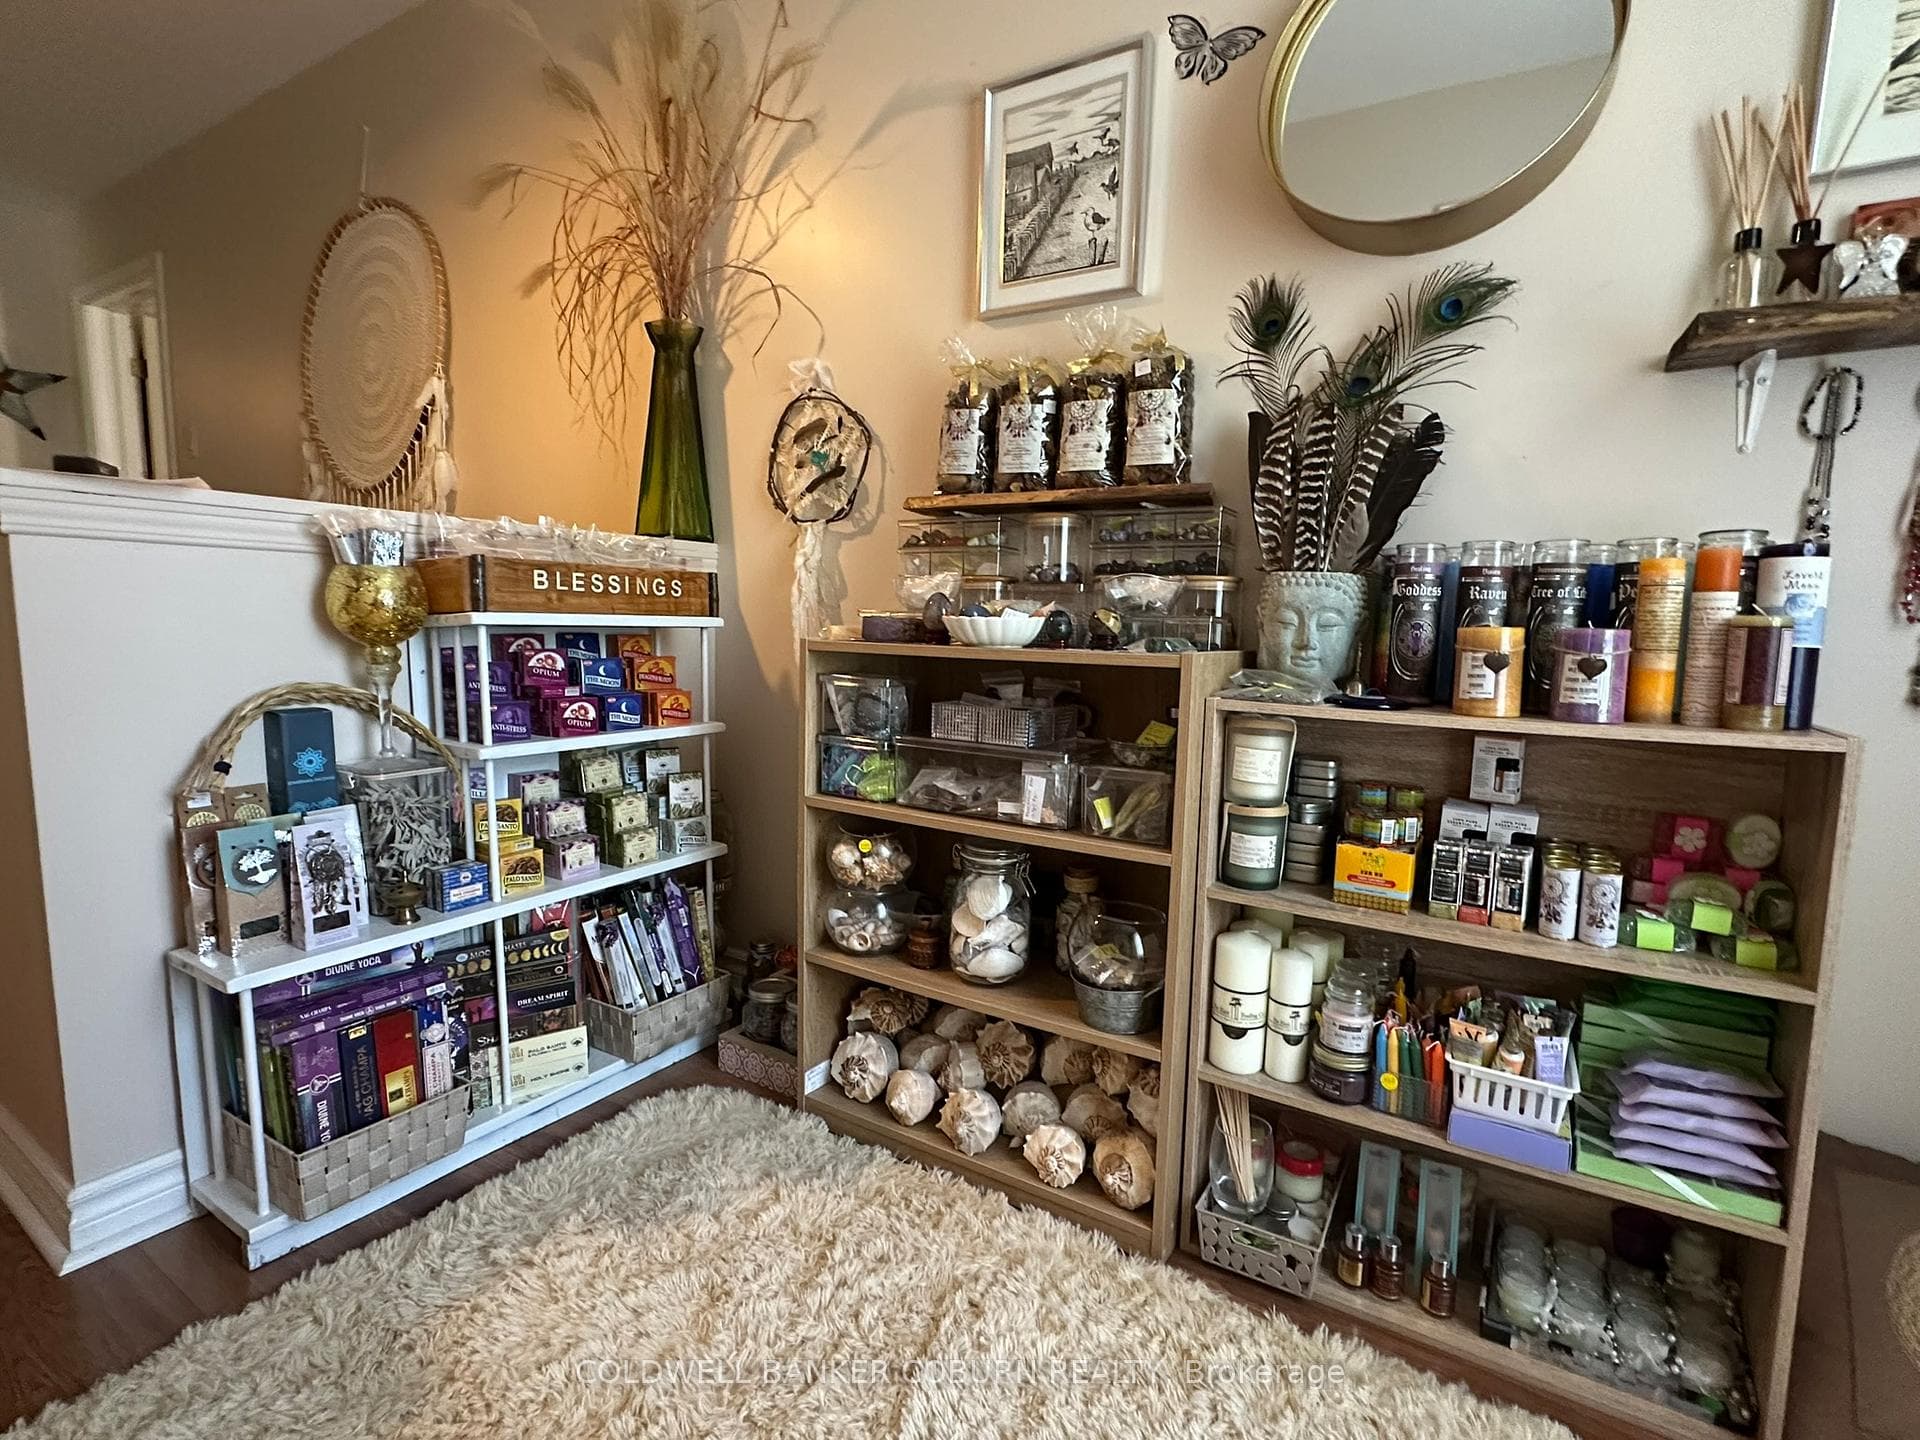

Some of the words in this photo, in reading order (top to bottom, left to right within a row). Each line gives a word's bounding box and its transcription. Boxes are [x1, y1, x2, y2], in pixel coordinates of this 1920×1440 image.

[533, 568, 682, 597] BLESSINGS
[1396, 583, 1442, 597] Goddess
[1469, 585, 1508, 601] Raven
[1557, 586, 1571, 599] of
[533, 667, 560, 678] OPIUM
[567, 719, 592, 728] OPIUM
[505, 875, 521, 883] PALO
[521, 874, 540, 882] SANTO
[325, 962, 356, 977] DIVINE
[357, 955, 382, 969] YOGA
[517, 996, 544, 1007] DREAM
[544, 990, 569, 1001] SPIRIT
[356, 1046, 373, 1094] CHAMPA
[315, 1100, 330, 1130] DIVINE
